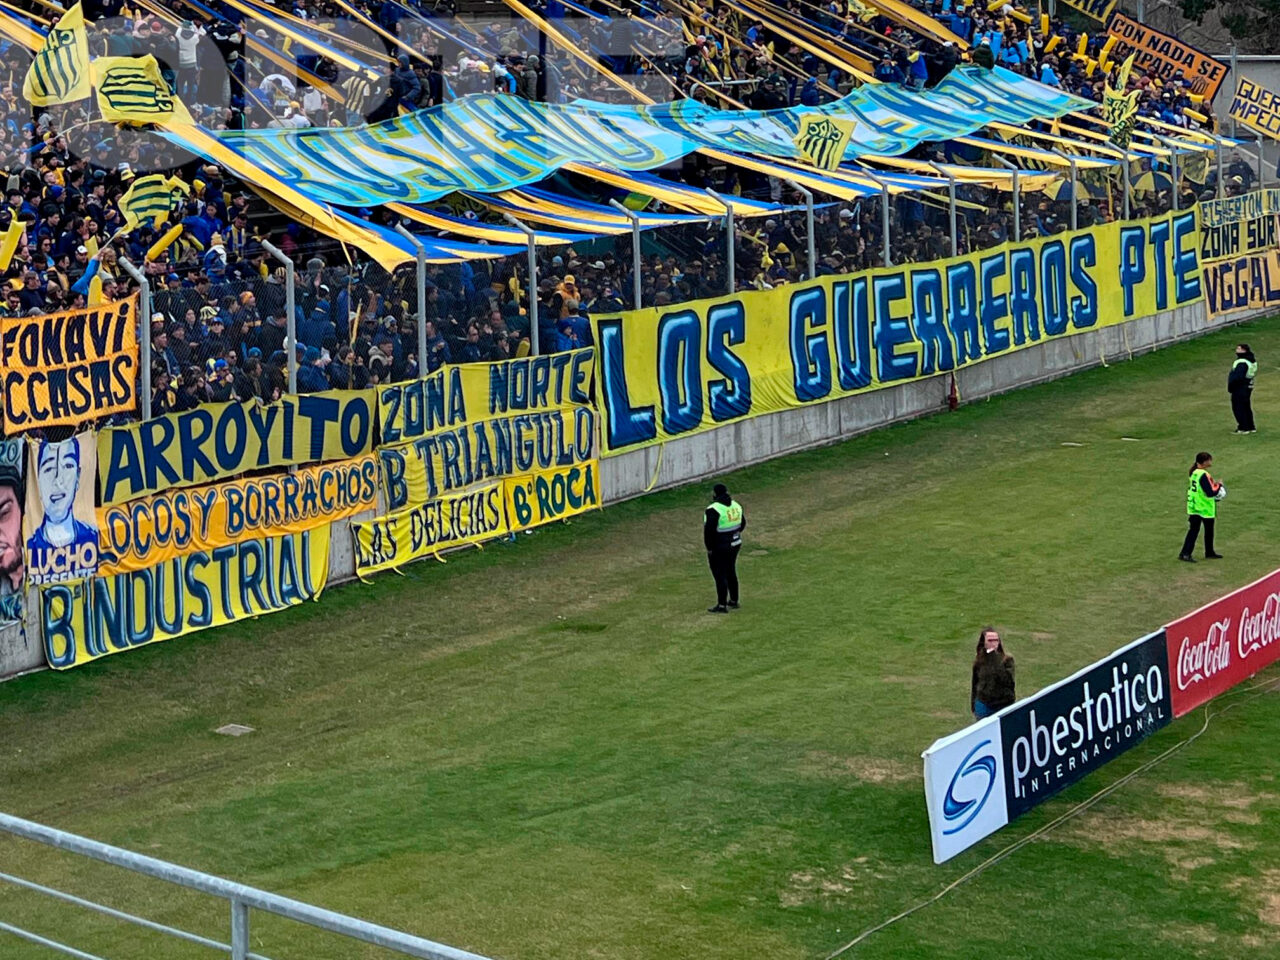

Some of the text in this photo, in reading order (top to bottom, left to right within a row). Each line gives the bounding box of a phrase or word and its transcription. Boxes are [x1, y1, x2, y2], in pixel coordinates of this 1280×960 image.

[1110, 18, 1223, 82] CON NADA SE
[1115, 40, 1186, 78] CMPAR
[1200, 214, 1276, 260] ZONA SUR
[595, 209, 1204, 451] LOS GUERREROS PTE
[380, 348, 595, 445] ZONA NORTE
[103, 396, 370, 504] ARROYITO
[414, 406, 594, 499] TRIANGULO
[223, 459, 377, 536] BORRACHOS
[350, 489, 500, 569] LAS DELICIAS
[534, 464, 597, 522] ROCA
[27, 542, 98, 575] LUCHO
[1177, 617, 1231, 691] Coca-Cola
[1011, 661, 1165, 798] pbestatica
[1021, 706, 1165, 798] INTERNACIONAL
